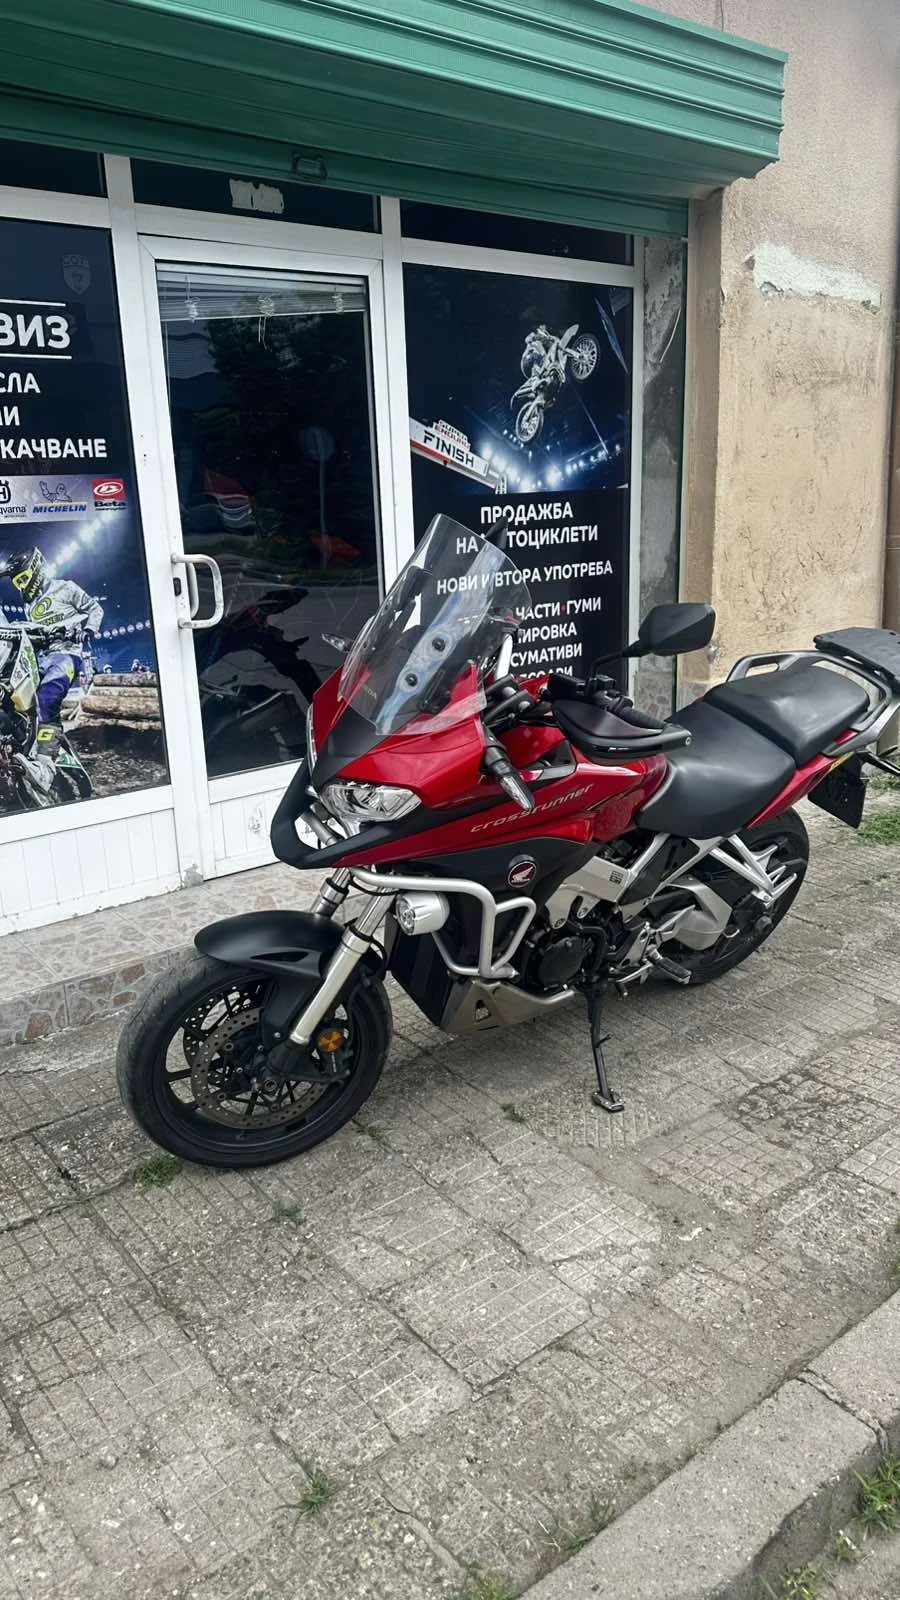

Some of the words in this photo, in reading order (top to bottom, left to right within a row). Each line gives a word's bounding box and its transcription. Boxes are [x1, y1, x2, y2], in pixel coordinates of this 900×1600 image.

[0, 313, 71, 349] ВИЗ
[0, 406, 21, 427] И
[0, 438, 108, 459] КАЧВАНЕ
[423, 430, 475, 468] FINISH
[32, 504, 87, 514] MICHELIN
[480, 501, 574, 526] ПРОДАЖБА
[456, 536, 479, 555] НА
[506, 525, 599, 550] ТОЦИКЛЕТИ
[436, 576, 478, 595] НОВИ
[495, 567, 542, 588] ВТОРА
[544, 560, 613, 583] УПОТРЕБА
[515, 601, 561, 621] ЧАСТИ
[566, 597, 602, 616] ГУМИ
[510, 642, 583, 668] СУМАТИВИ
[470, 783, 595, 834] crossrunner
